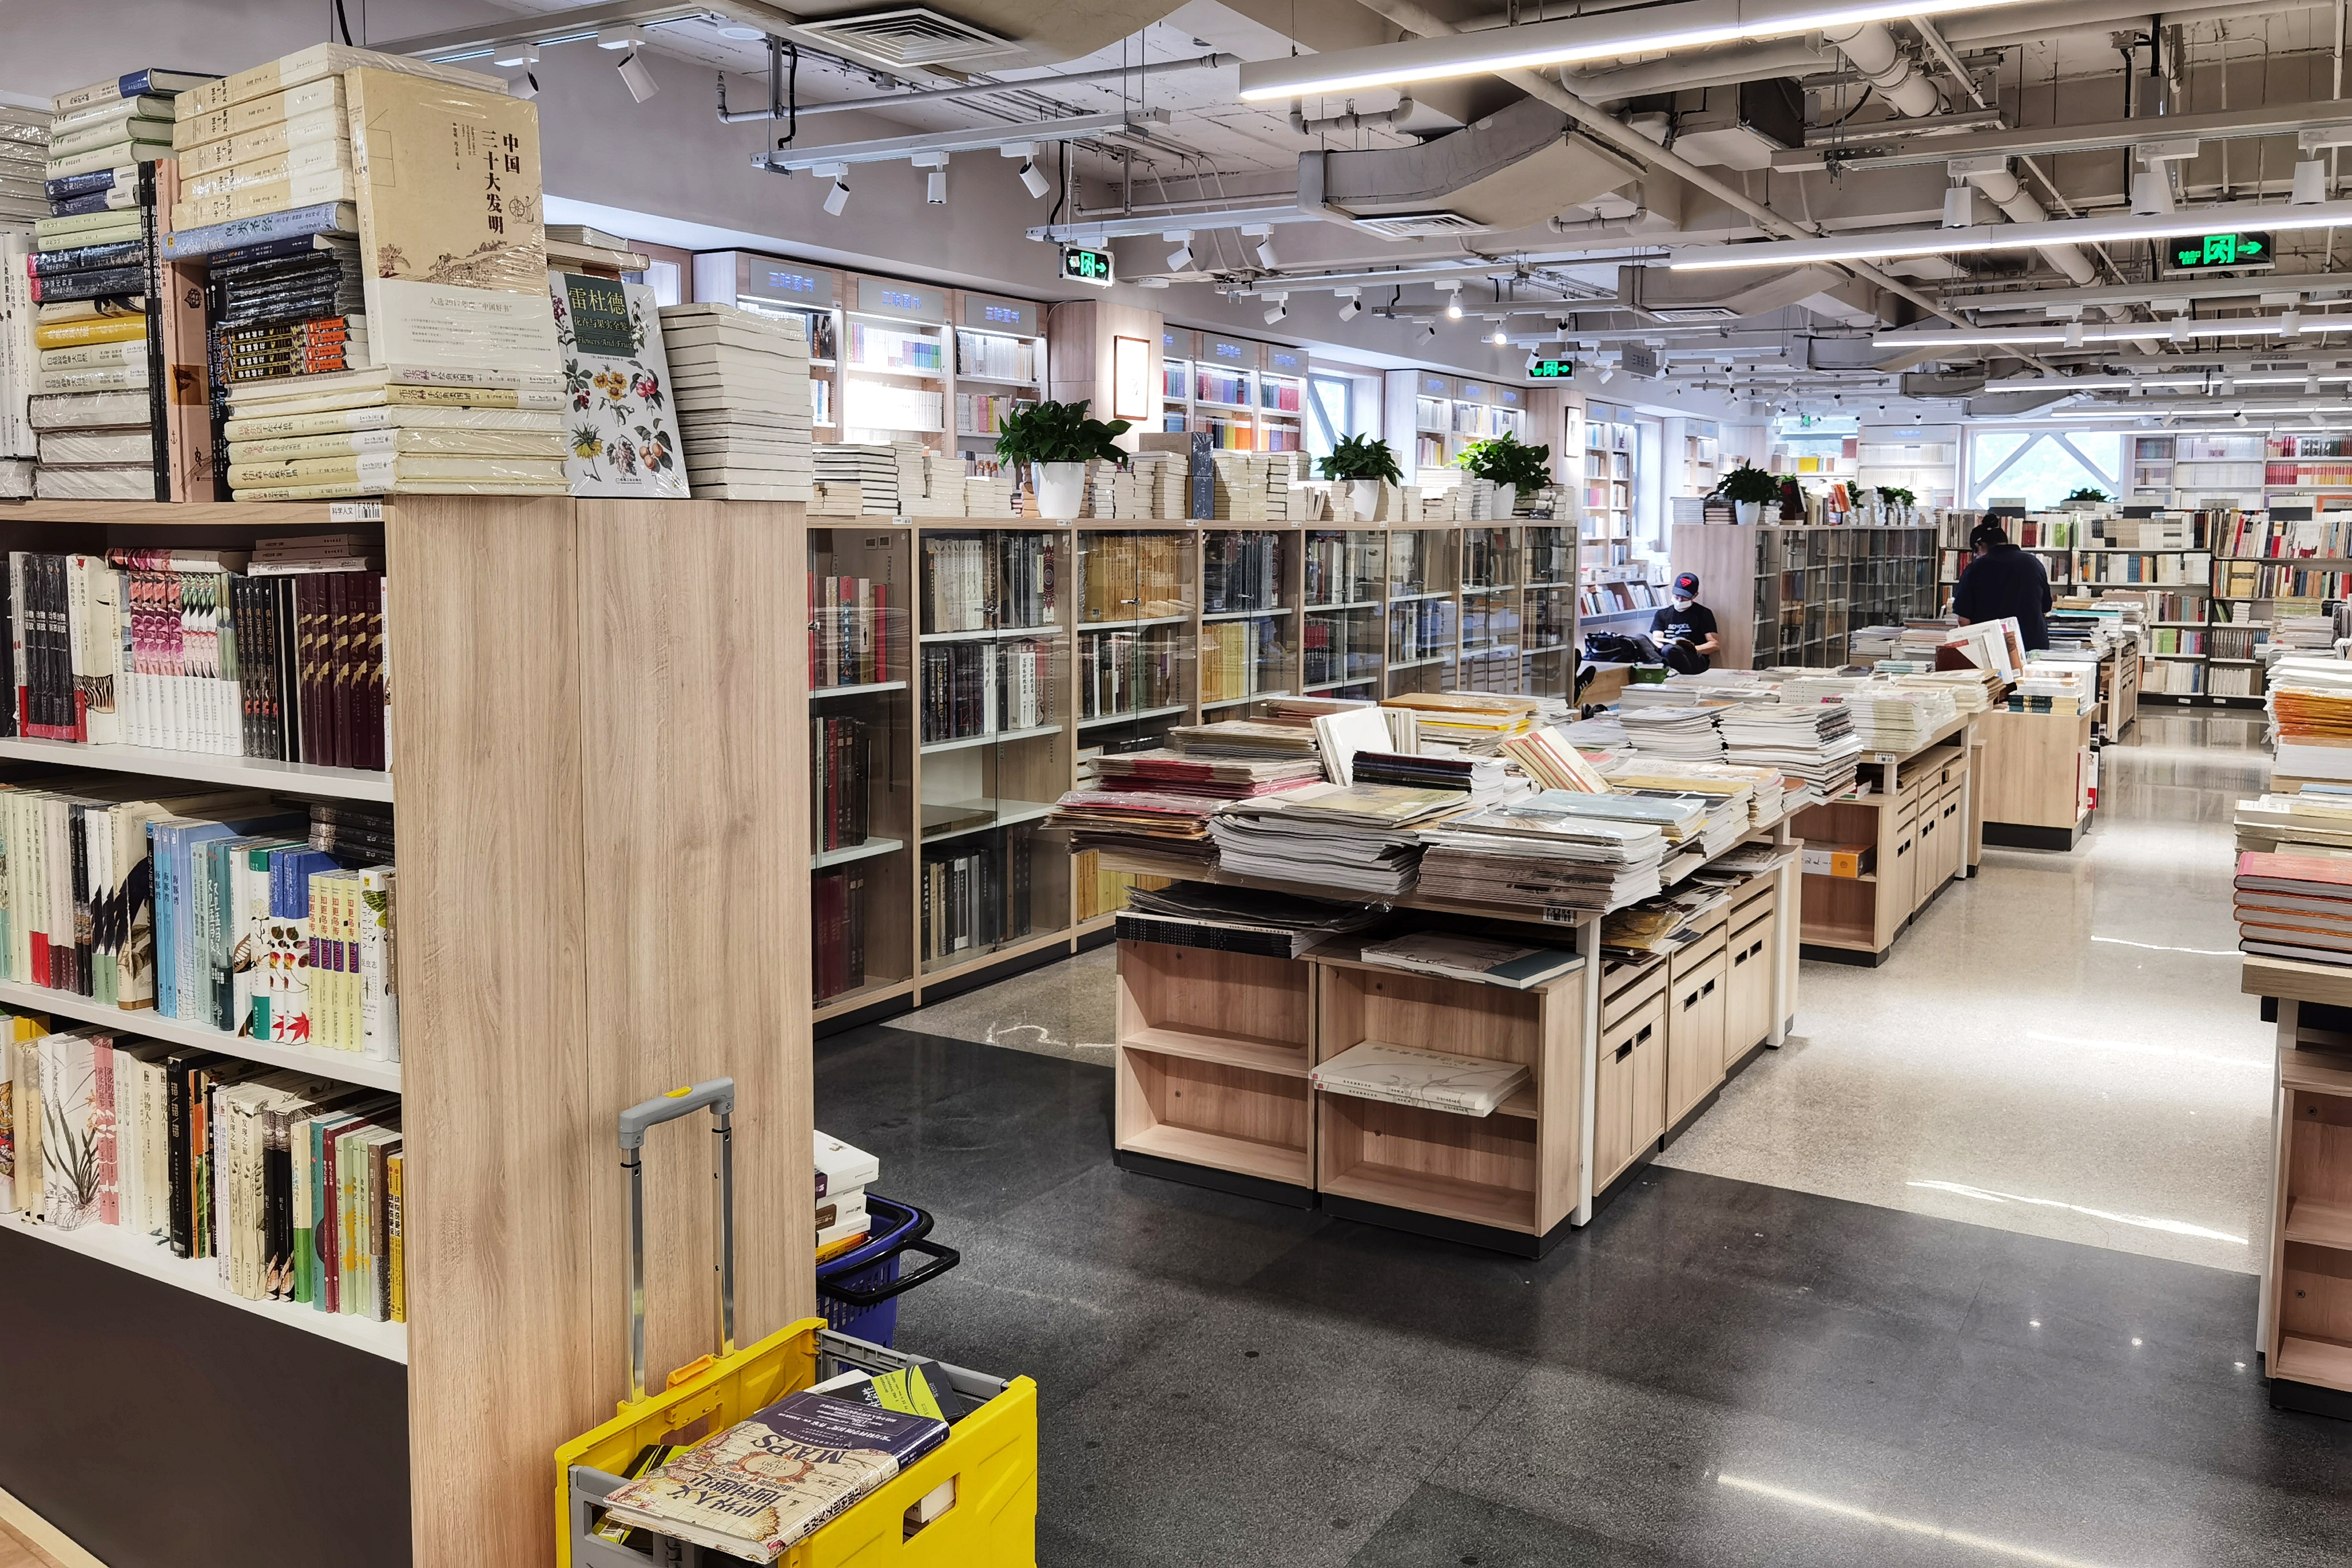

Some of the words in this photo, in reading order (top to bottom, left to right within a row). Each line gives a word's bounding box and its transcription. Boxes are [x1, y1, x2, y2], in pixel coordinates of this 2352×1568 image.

[503, 133, 520, 174] 中国
[481, 130, 504, 235] 三十大发明
[768, 272, 815, 293] 三联图书
[568, 287, 626, 315] 雷杜德
[882, 291, 922, 310] 三联图书
[573, 317, 629, 333] 花卉与果实全鉴
[577, 335, 601, 346] Flowers
[601, 337, 616, 348] And
[617, 339, 633, 350] Fruit
[332, 506, 354, 516] 科学人文
[144, 1091, 152, 1130] 博物人生
[750, 1434, 850, 1465] MAPS
[760, 1461, 789, 1470] STORY
[666, 1485, 767, 1519] 世界人文
[687, 1473, 787, 1506] 地图趣史
